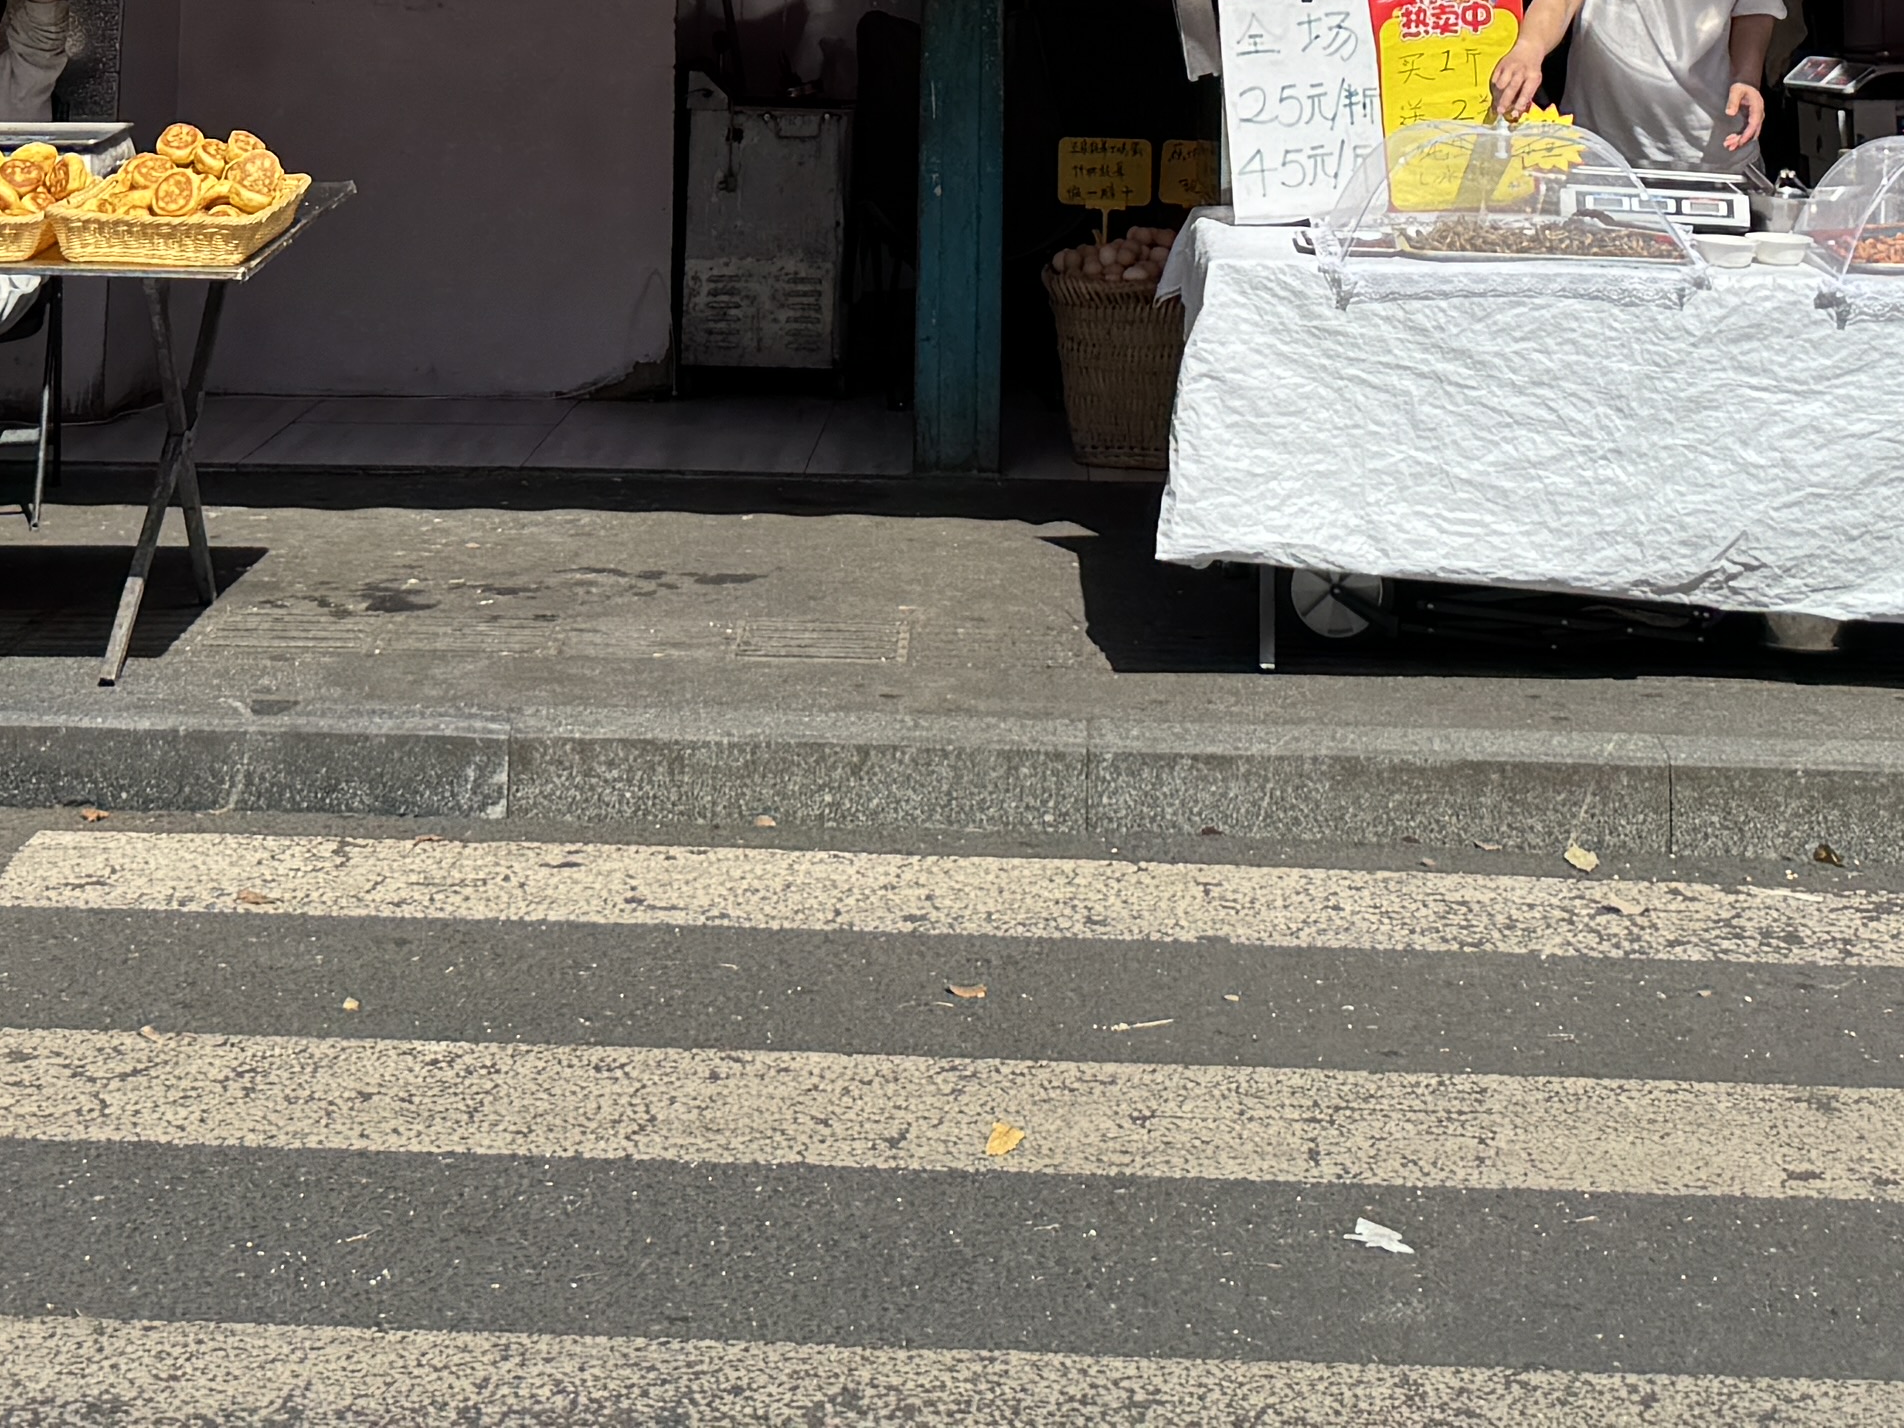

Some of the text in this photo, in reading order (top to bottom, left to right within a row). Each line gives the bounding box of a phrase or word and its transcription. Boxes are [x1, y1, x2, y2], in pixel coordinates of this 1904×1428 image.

[1236, 10, 1361, 61] 全场
[1400, 0, 1493, 40] 热卖中
